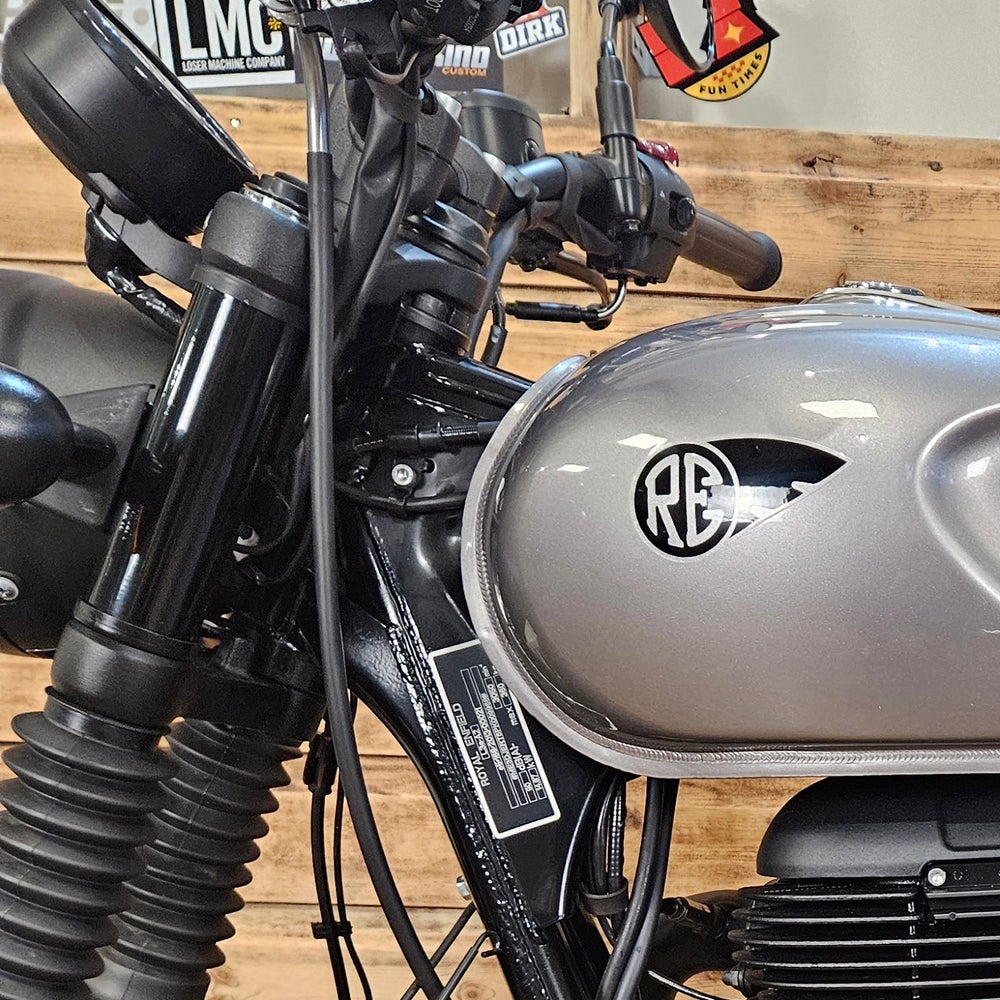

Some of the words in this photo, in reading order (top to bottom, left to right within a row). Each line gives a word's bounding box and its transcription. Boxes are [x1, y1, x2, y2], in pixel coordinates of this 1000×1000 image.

[174, 0, 283, 59] LMC
[500, 12, 564, 50] DIRK
[181, 60, 207, 73] LOSER
[207, 58, 245, 72] MACHINE
[246, 55, 286, 70] COMPANY
[441, 67, 487, 77] CUSTOM
[700, 85, 727, 95] FUN
[732, 53, 763, 88] TIMES
[644, 452, 724, 549] RE
[450, 701, 475, 747] ENFIELD
[505, 705, 519, 726] max
[468, 749, 490, 787] ROYAL
[521, 752, 536, 769] kW
